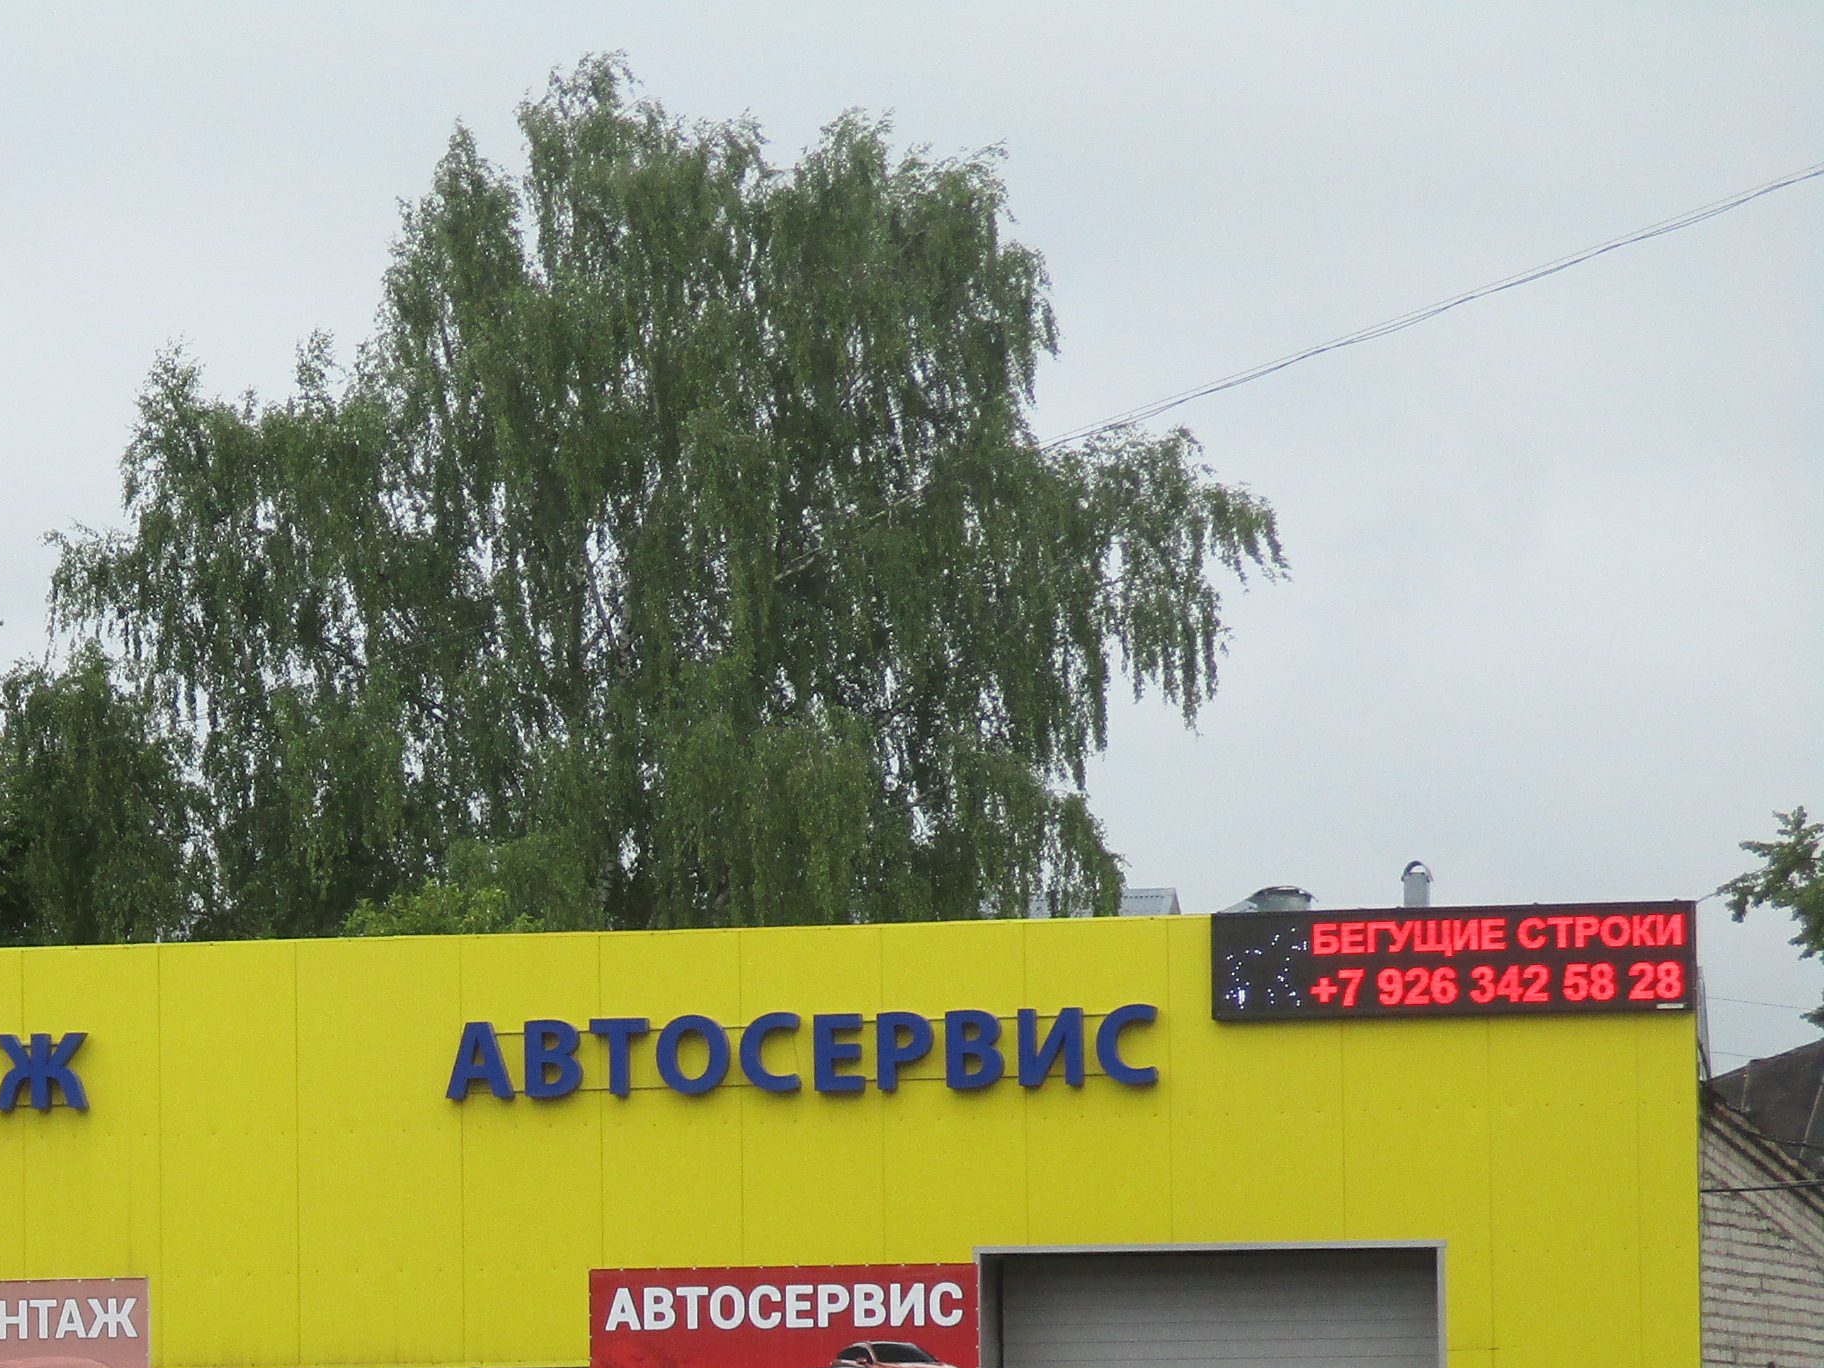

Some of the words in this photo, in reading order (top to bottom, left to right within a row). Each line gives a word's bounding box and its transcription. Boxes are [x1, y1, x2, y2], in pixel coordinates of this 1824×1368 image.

[1311, 918, 1507, 957] БЕГУЩИЕ
[1517, 914, 1684, 949] СТРОКИ
[1310, 967, 1365, 1008] +7
[1378, 966, 1457, 1006] 926
[1470, 964, 1549, 1003] 342
[1563, 962, 1615, 1001] 58
[1628, 961, 1683, 1001] 28
[445, 1003, 1159, 1100] АВТОСЕРВИС
[605, 1282, 964, 1332] АВТОСЕРВИС
